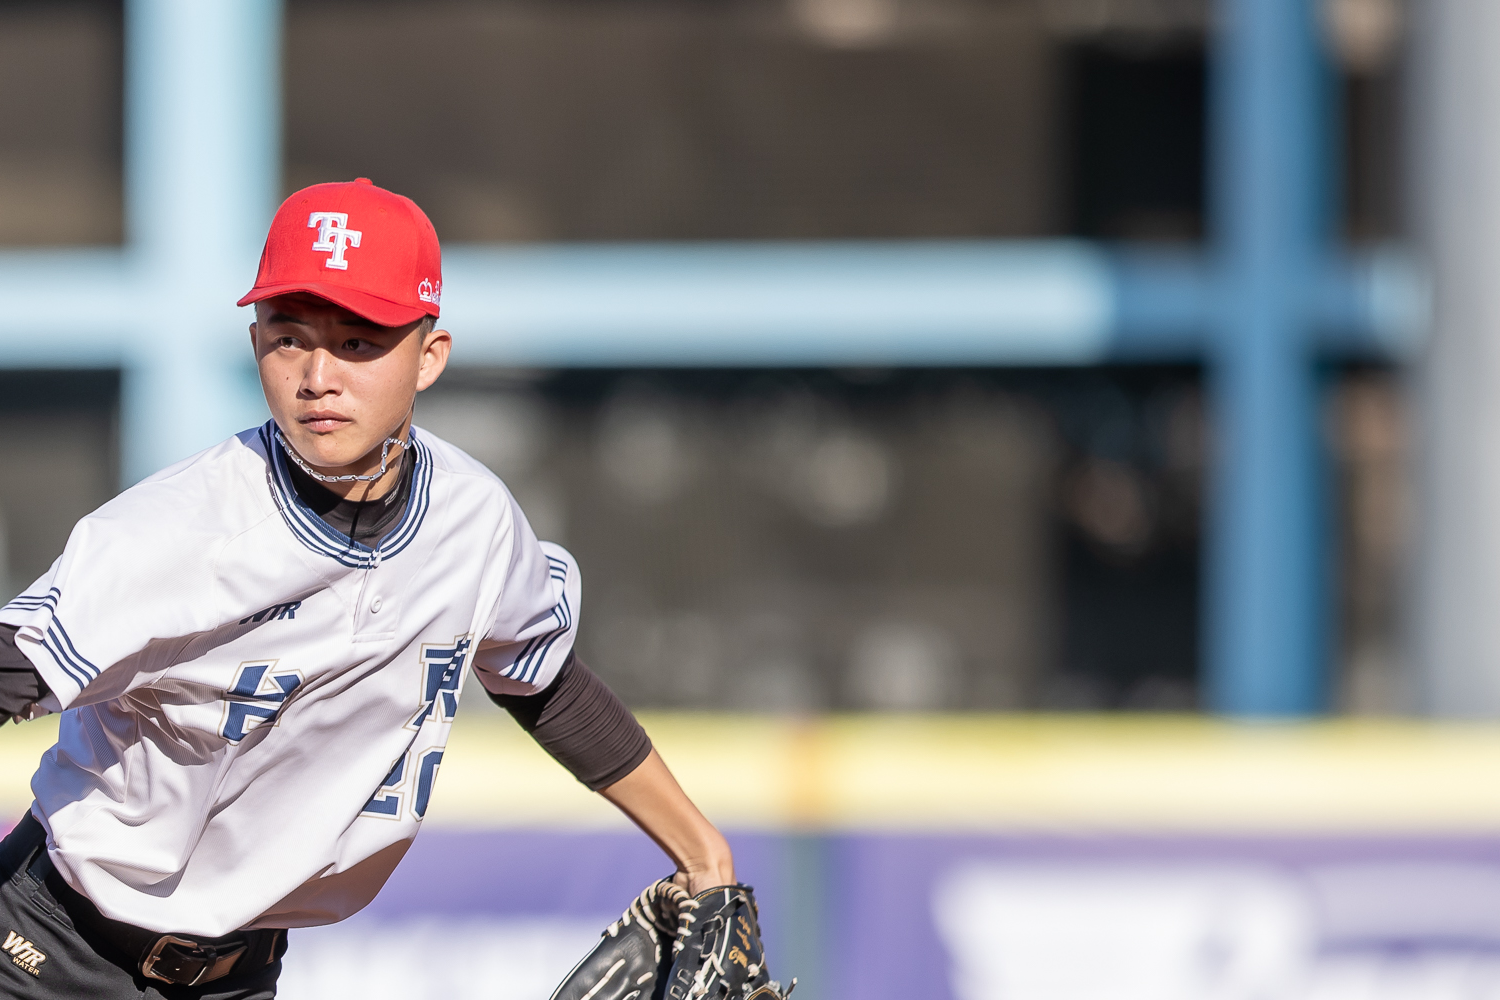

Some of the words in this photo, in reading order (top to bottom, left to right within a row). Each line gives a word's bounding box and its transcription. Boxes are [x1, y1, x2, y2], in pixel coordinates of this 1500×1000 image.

[307, 211, 362, 270] TT
[1, 930, 47, 967] WTR
[12, 956, 40, 976] WATER
